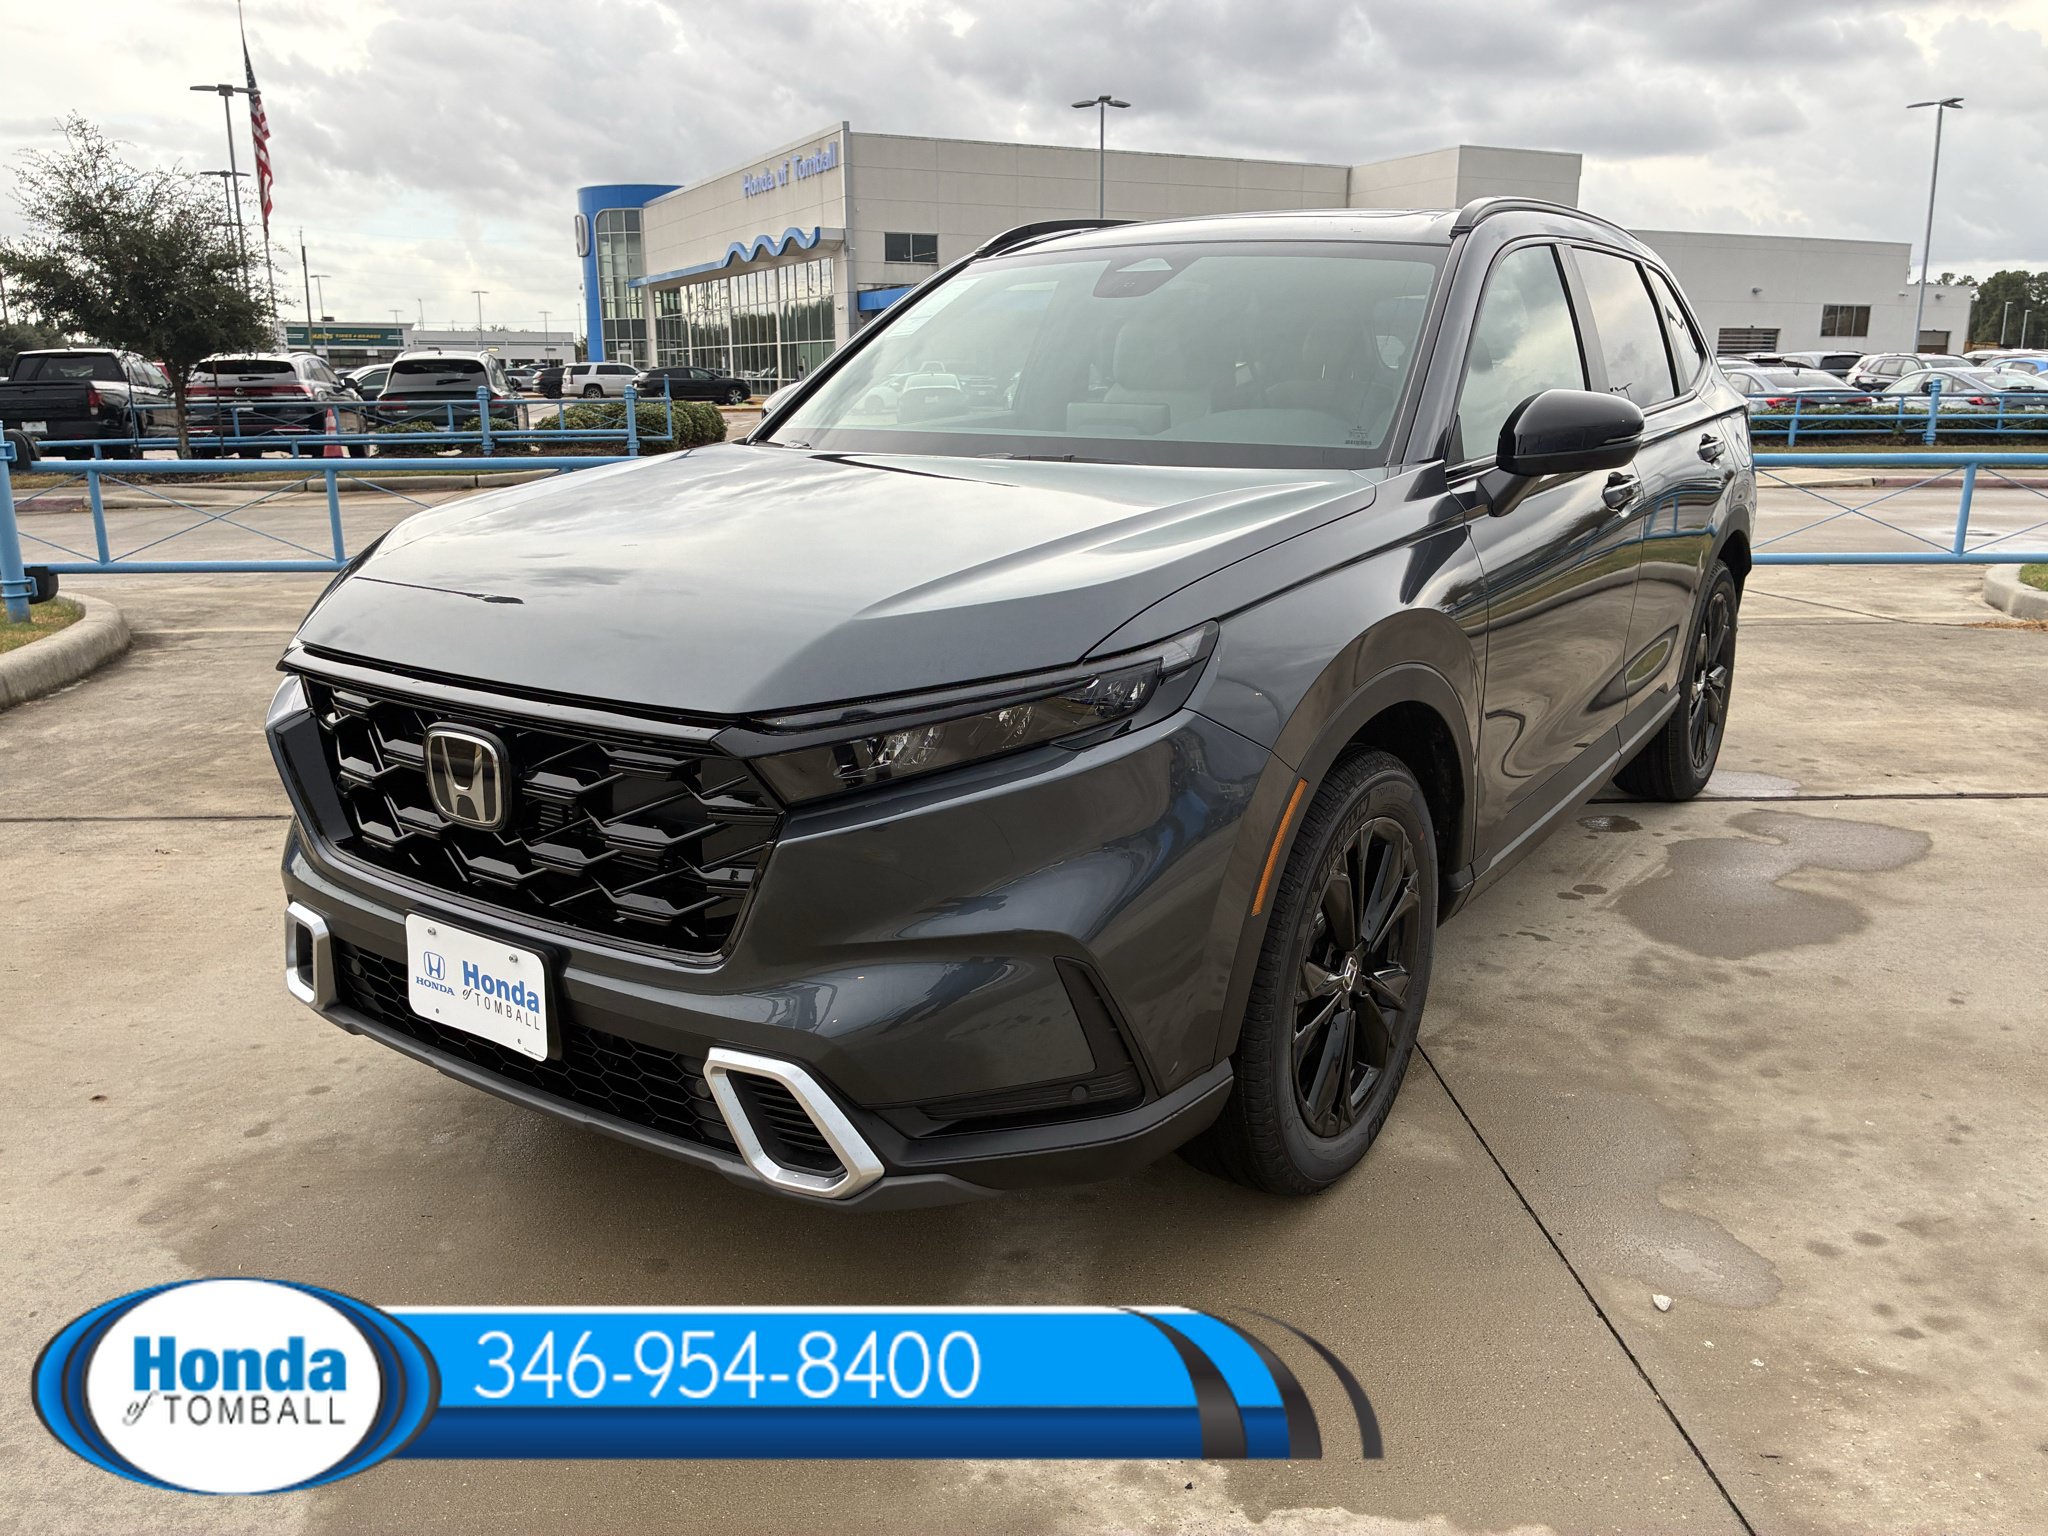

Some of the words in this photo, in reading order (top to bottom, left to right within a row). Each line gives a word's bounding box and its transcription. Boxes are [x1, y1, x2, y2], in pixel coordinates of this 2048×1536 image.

[743, 168, 776, 198] Honda
[777, 160, 789, 187] of
[791, 141, 839, 181] Tomball
[415, 976, 455, 996] HONDA
[462, 960, 540, 1014] Honda
[462, 987, 474, 1000] of
[474, 992, 540, 1031] TOMBALL
